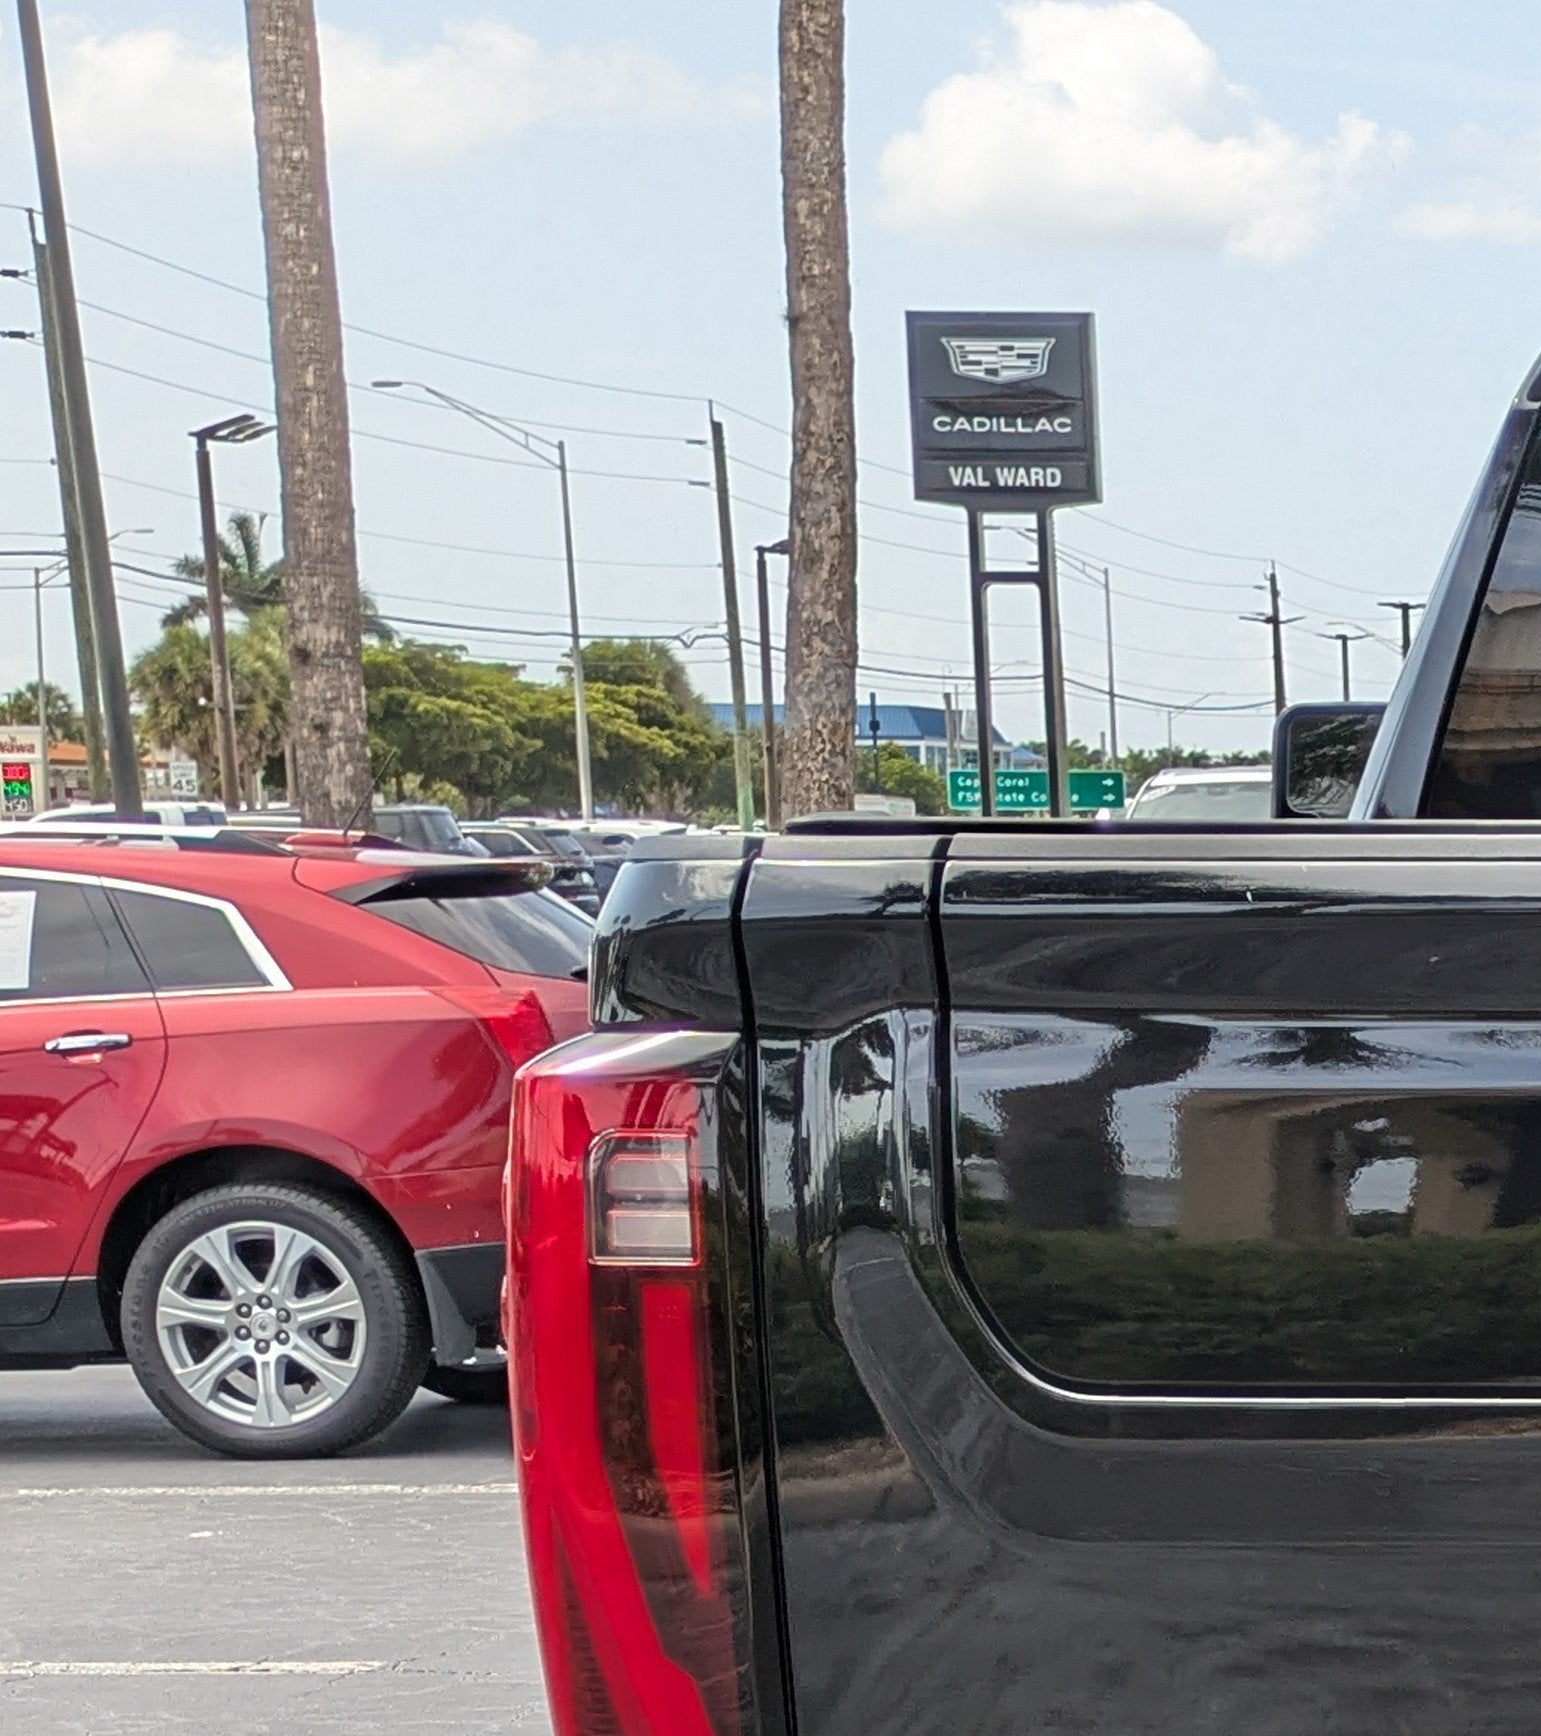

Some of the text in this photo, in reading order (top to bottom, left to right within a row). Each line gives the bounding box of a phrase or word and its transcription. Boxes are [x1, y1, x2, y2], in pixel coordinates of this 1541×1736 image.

[932, 415, 1073, 434] CADILLAC
[948, 466, 1063, 488] VAL WARD
[173, 779, 195, 793] 45
[957, 776, 1030, 788] Cap Coral
